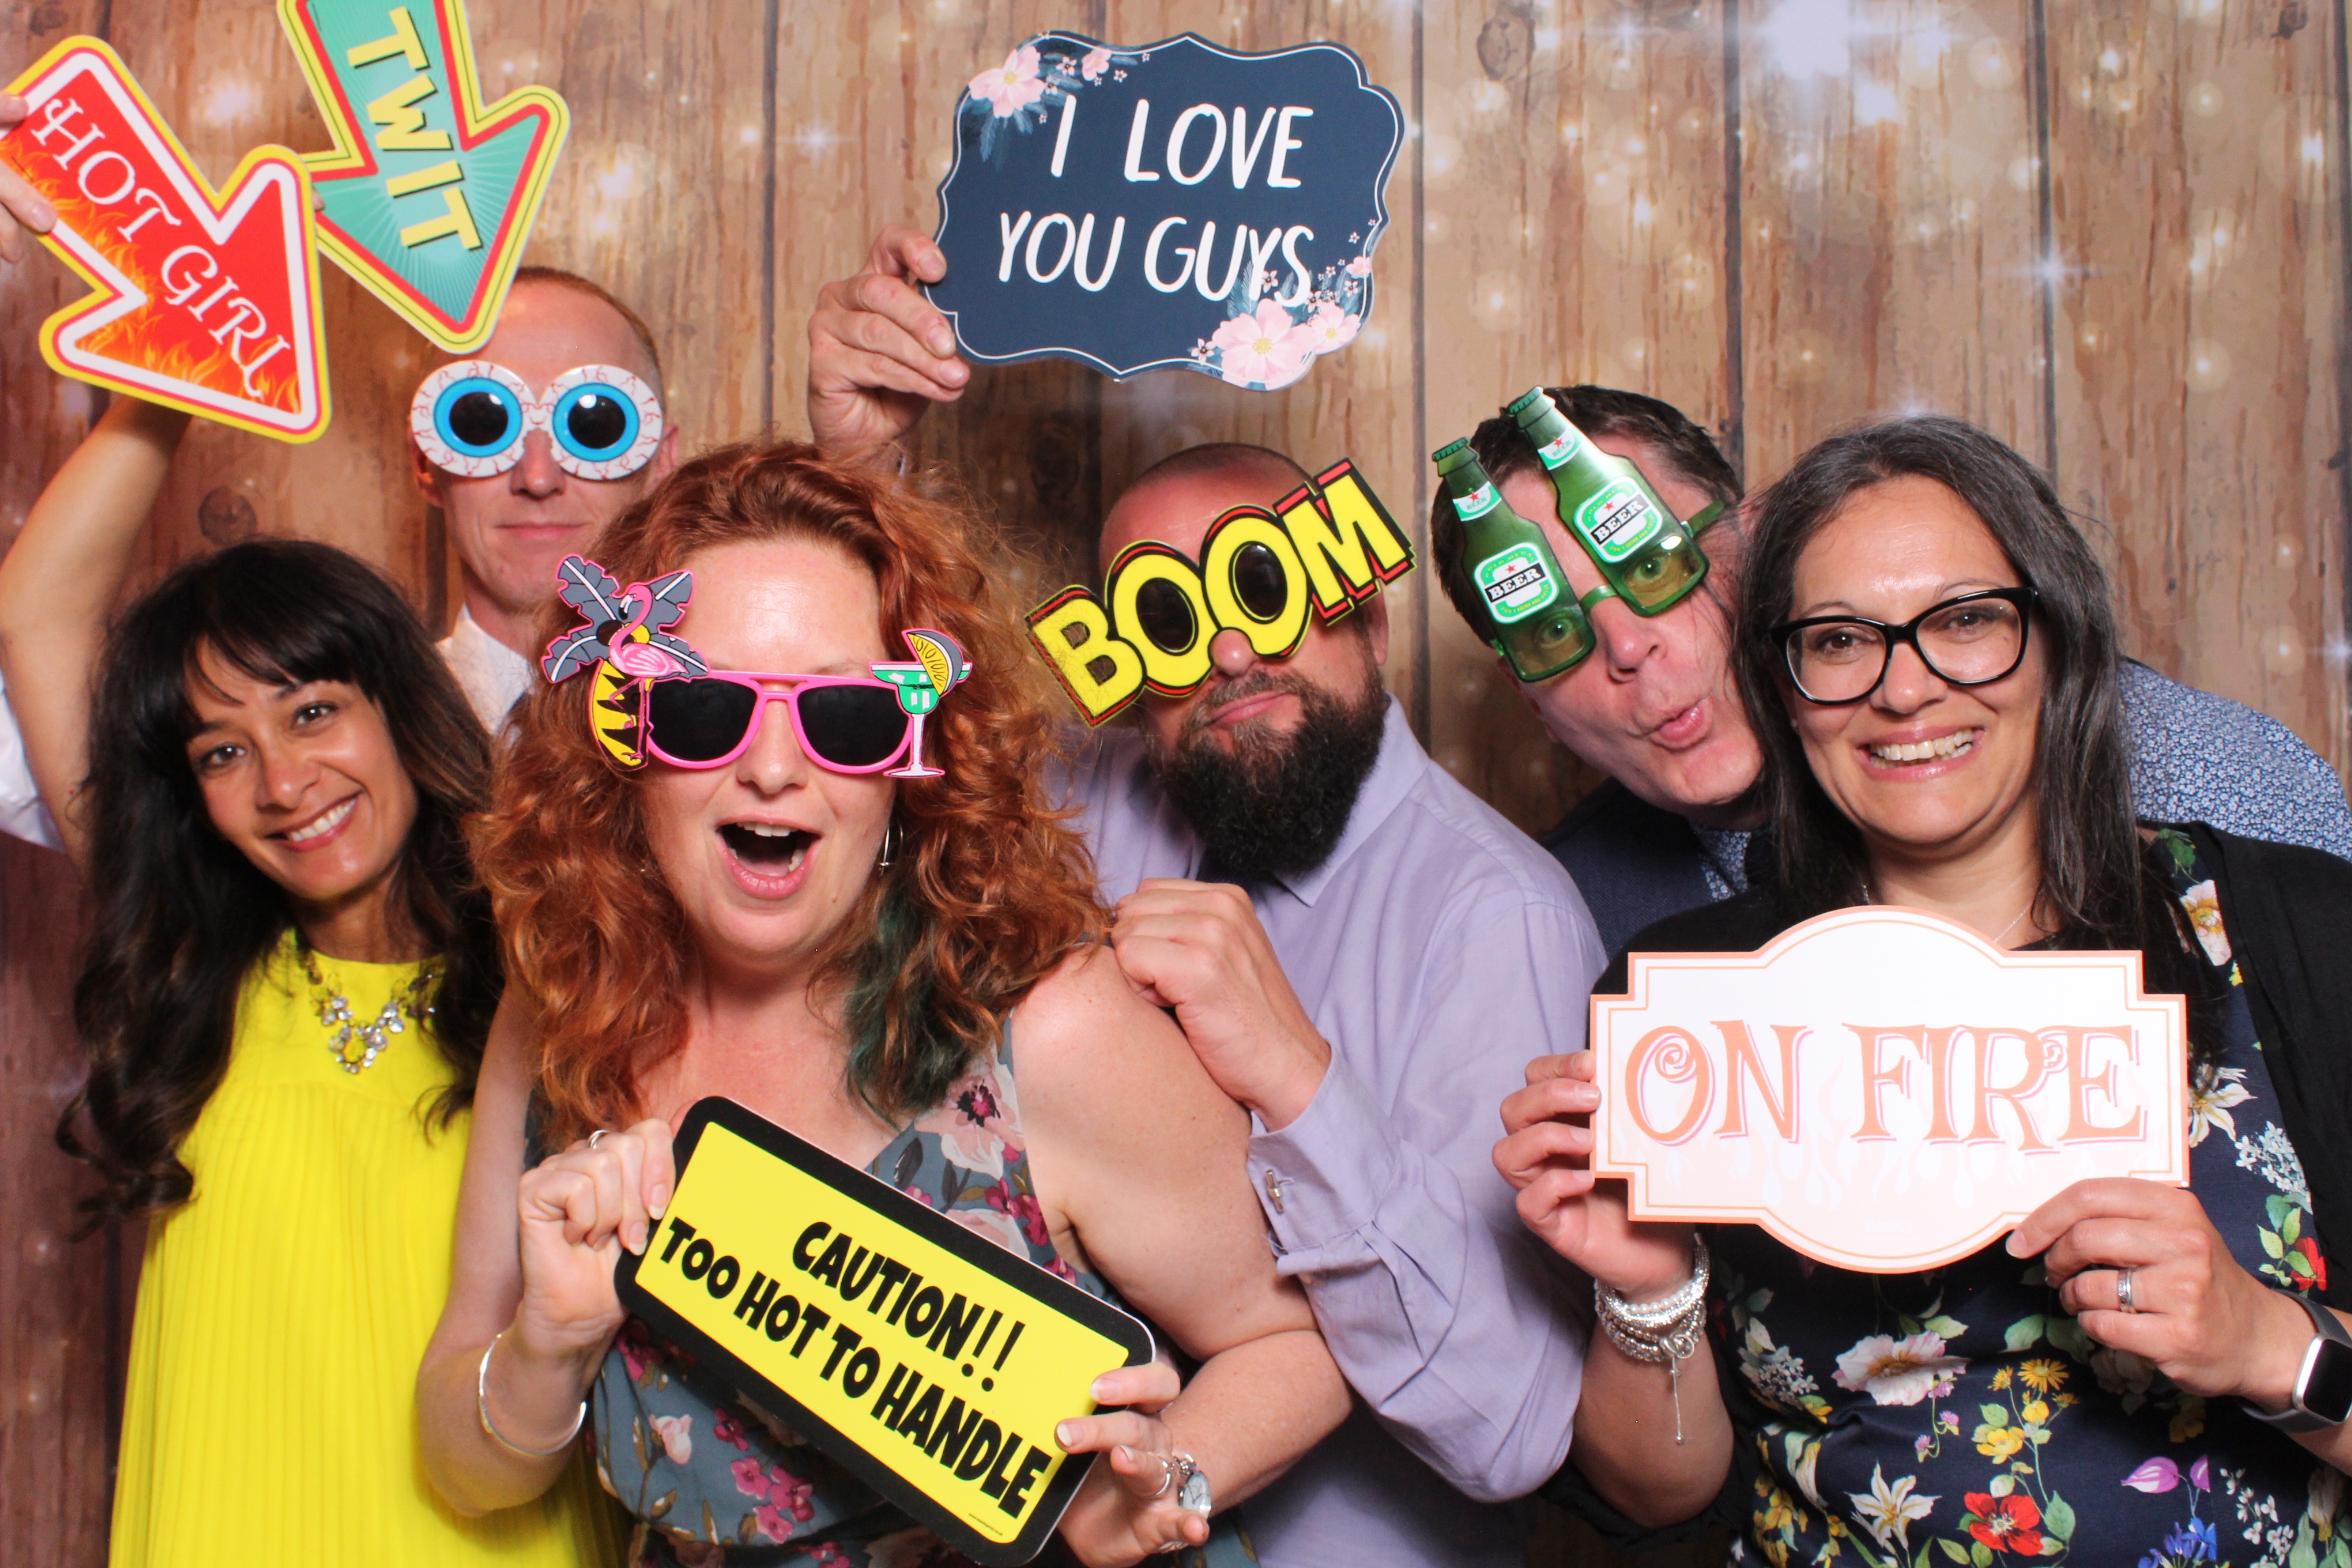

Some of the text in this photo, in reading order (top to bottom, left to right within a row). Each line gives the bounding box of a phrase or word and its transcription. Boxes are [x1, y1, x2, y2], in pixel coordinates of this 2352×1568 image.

[345, 5, 483, 252] TWIT
[1050, 94, 1314, 190] I LOVE
[31, 97, 291, 399] HOT GIRL
[1000, 210, 1315, 308] YOU GUYS
[1467, 496, 1487, 510] BEER
[1593, 501, 1644, 542] BEER
[1026, 457, 1415, 727] BOOM
[1488, 568, 1542, 600] BEER
[1624, 1019, 2148, 1156] ON FIRE
[659, 1216, 1053, 1520] TOO HOT TO HANDLE
[792, 1222, 1026, 1393] CAUTION!!
